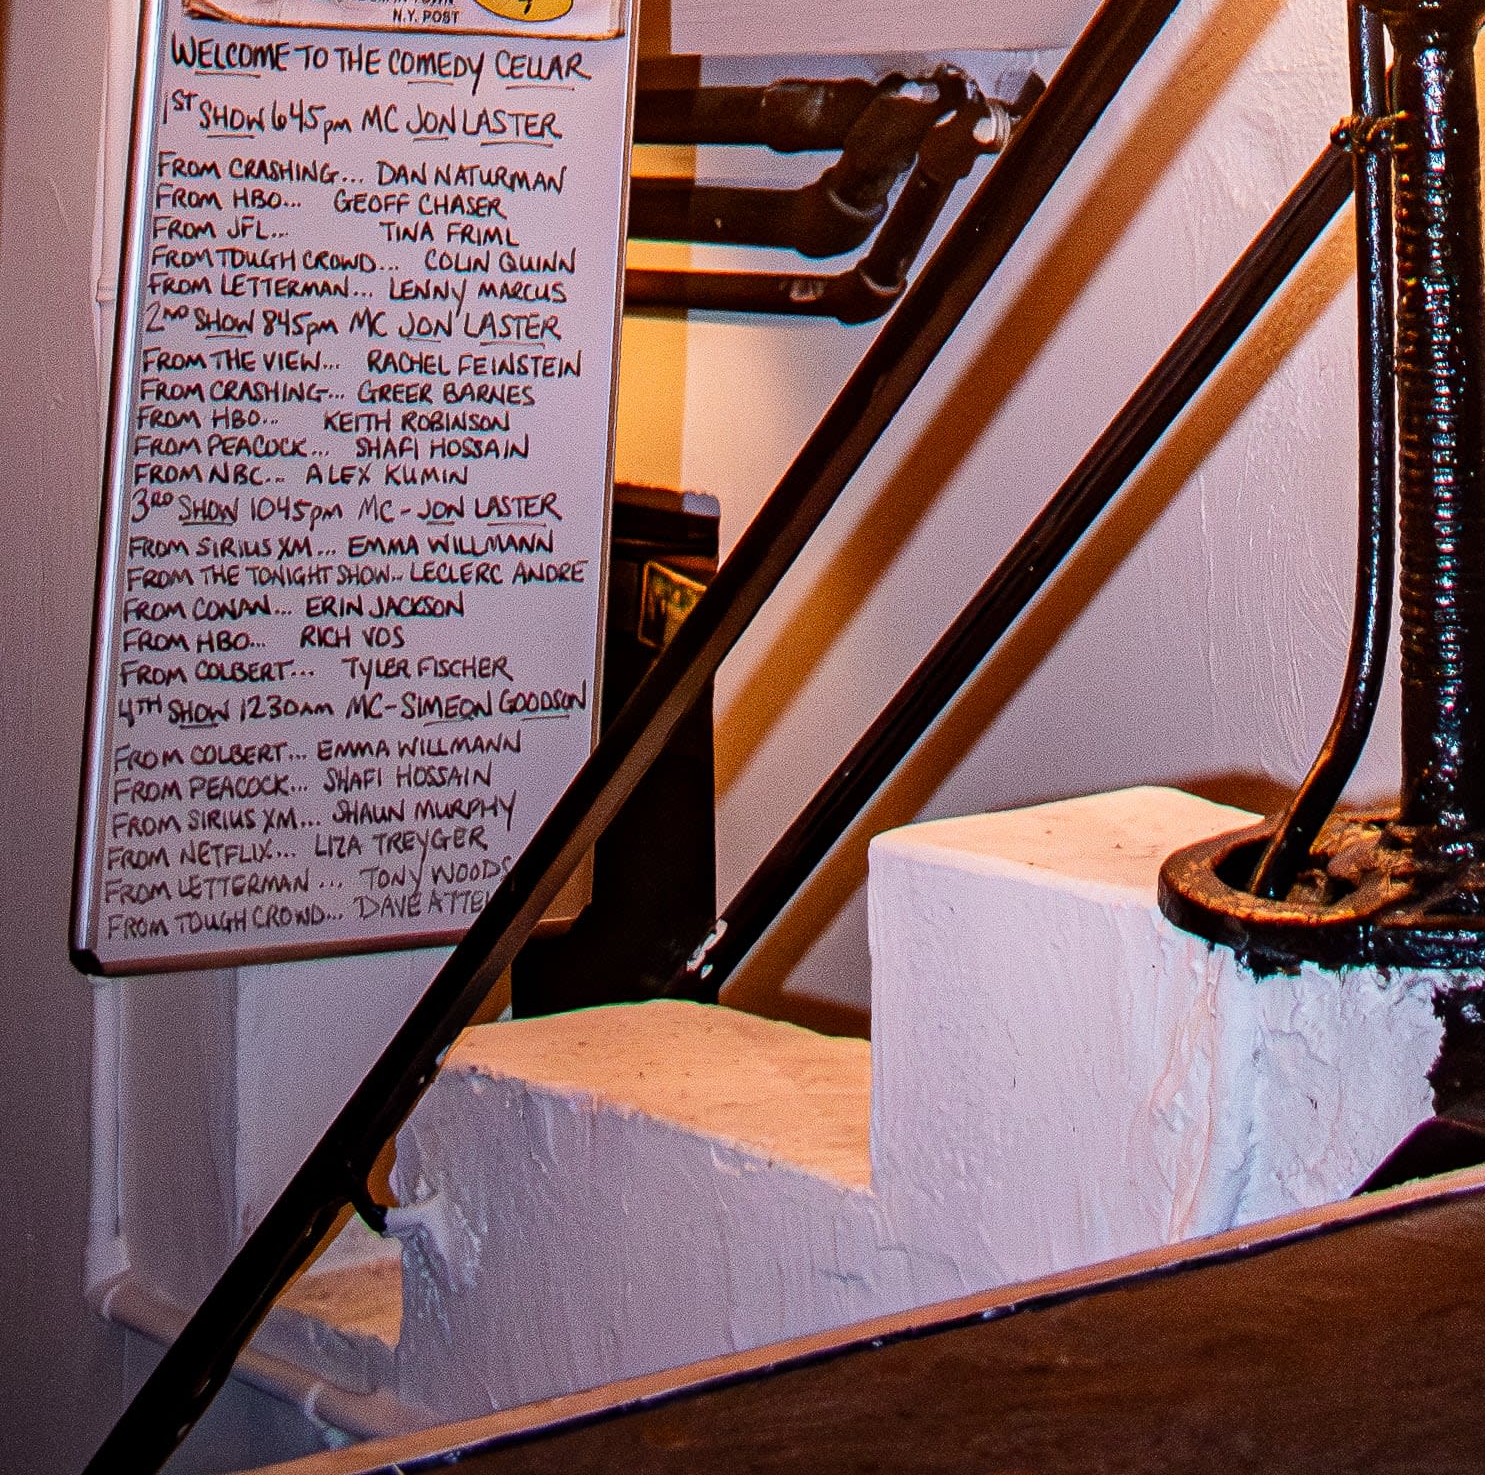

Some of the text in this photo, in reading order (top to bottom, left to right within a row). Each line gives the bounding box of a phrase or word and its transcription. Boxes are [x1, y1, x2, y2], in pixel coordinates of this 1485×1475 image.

[393, 8, 461, 24] N.Y. POST
[172, 30, 592, 96] WELCOME TO THE COMEDY CELLAR
[200, 99, 265, 133] SHOW
[362, 103, 398, 133] MC
[406, 103, 456, 134] JON
[462, 107, 563, 140] LASTER
[158, 150, 222, 179] FROM
[376, 159, 427, 186] DAN
[435, 162, 568, 195] NATURMAN
[155, 182, 223, 211] FROM
[333, 188, 411, 214] GEOFF
[418, 192, 508, 220] CHASER
[152, 215, 217, 239] FROM
[379, 220, 435, 242] TINA
[447, 221, 520, 247] FRIML
[151, 244, 214, 268] FROM
[215, 247, 296, 271] TOUGH
[425, 248, 490, 272] COLIN
[499, 247, 577, 275] QUINN
[148, 272, 213, 295] FROM
[389, 277, 467, 318] LENNY
[478, 280, 567, 303] MARCUS
[194, 307, 255, 334] SHOW
[349, 306, 388, 338] MC
[398, 310, 452, 338] JON
[463, 311, 561, 341] LASTER
[143, 346, 207, 372] FROM
[209, 348, 256, 371] THE
[367, 349, 450, 375] RACHEL
[458, 350, 582, 378] FEINSTEIN
[140, 378, 205, 401] FROM
[358, 379, 433, 404] GREER
[443, 382, 535, 406] BARNES
[137, 405, 201, 429] FROM
[324, 409, 391, 434] KEITH
[401, 410, 509, 433] ROBINSON
[135, 436, 201, 456] FROM
[356, 436, 419, 460] SHAFI
[430, 433, 529, 460] HOSSAIN
[134, 463, 203, 484] FROM
[305, 463, 371, 486] ALEX
[385, 463, 468, 486] KUMIN
[178, 494, 239, 522] SHOW
[474, 492, 563, 521] LASTER
[129, 535, 189, 559] FROM
[196, 536, 272, 558] SIRIUS
[348, 534, 419, 557] EMMA
[427, 529, 554, 556] WILLMANN
[127, 566, 194, 591] FROM
[200, 564, 239, 586] THE
[245, 564, 333, 587] TONIGHT
[410, 561, 503, 584] LECLERC
[512, 559, 589, 585] ANDRE
[123, 597, 187, 623] FROM
[306, 594, 363, 618] ERIN
[368, 590, 464, 618] JACKSON
[123, 628, 190, 652] FROM
[300, 625, 350, 649] RICH
[362, 625, 405, 649] VOS
[121, 660, 188, 687] FROM
[341, 657, 411, 690] TYLER
[417, 655, 514, 681] FISCHER
[168, 699, 230, 724] SHOW
[114, 743, 185, 772] FROM
[317, 739, 390, 761] EMMA
[397, 728, 521, 759] WILLMANN
[113, 778, 183, 804] FROM
[323, 763, 382, 793] SHAFI
[396, 760, 492, 787] HOSSAIN
[112, 812, 182, 838] FROM
[188, 808, 256, 830] SIRIUS
[332, 799, 405, 825] SHAUN
[414, 789, 517, 831] MURPHY
[108, 846, 170, 870] FROM
[314, 833, 362, 859] LIZA
[372, 825, 489, 862] TREYGER
[105, 878, 172, 905] FROM
[359, 862, 424, 893] TONY
[108, 914, 169, 940] FROM
[174, 908, 247, 934] TOUGH
[353, 891, 422, 920] DAVE
